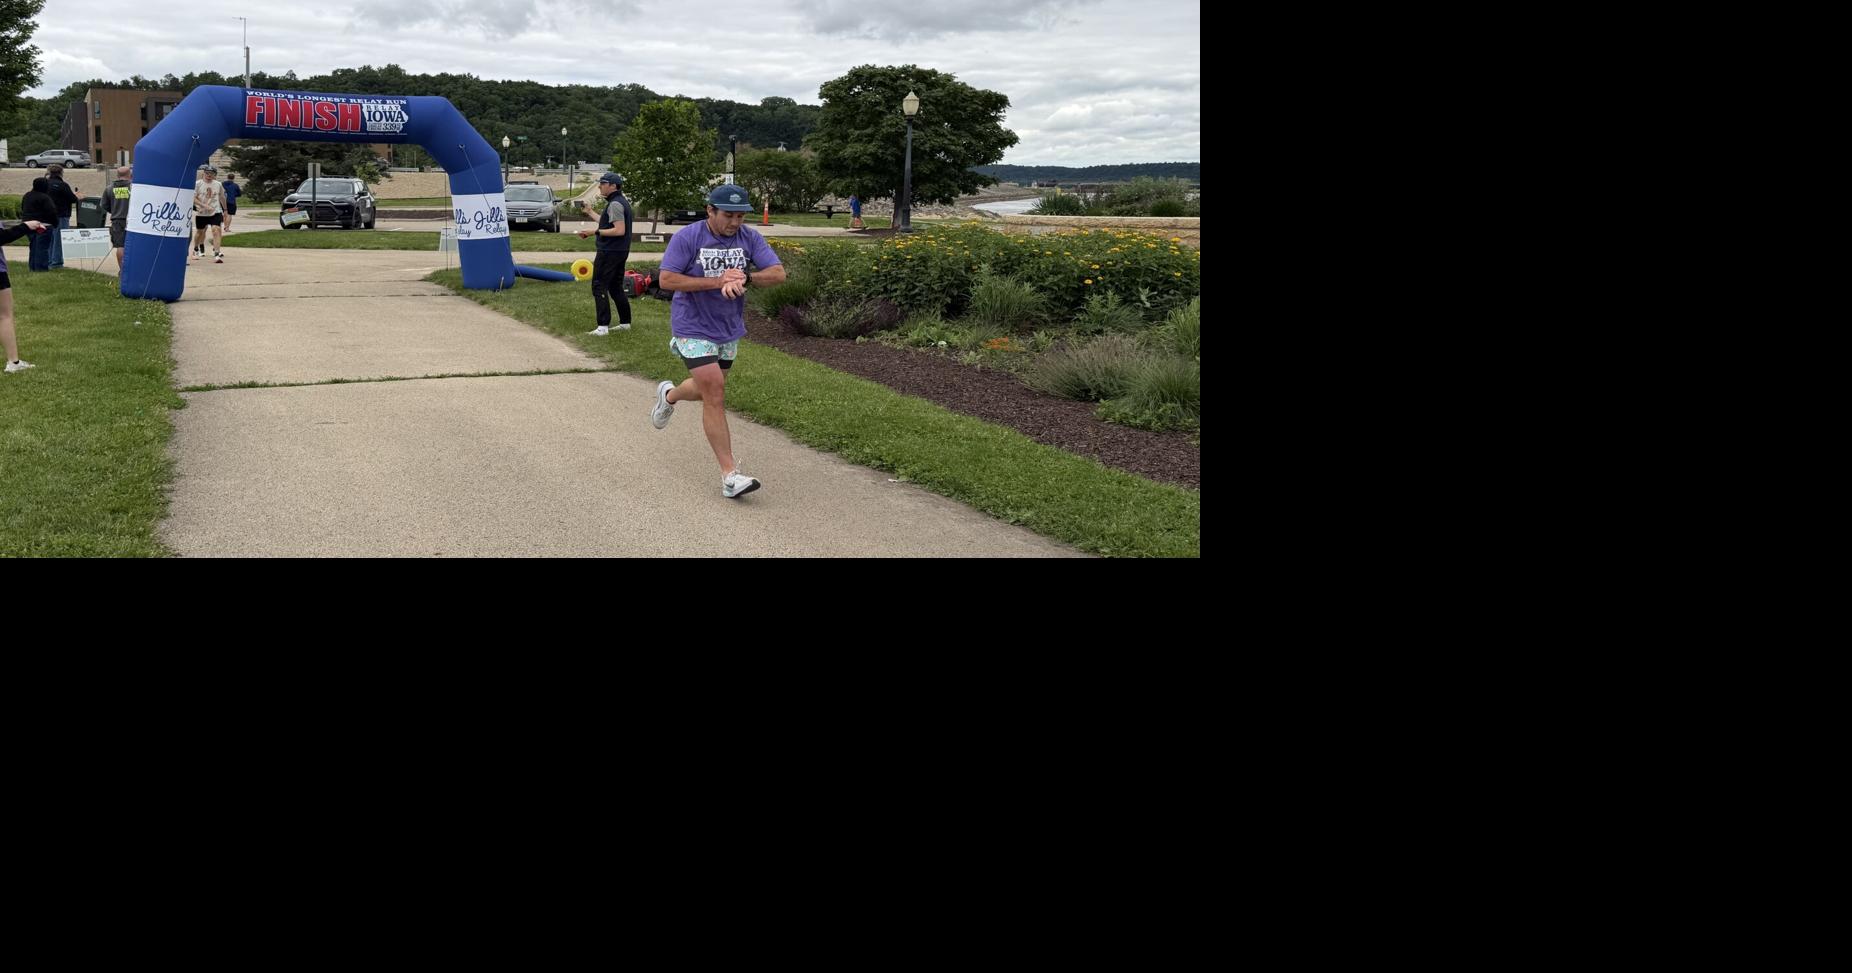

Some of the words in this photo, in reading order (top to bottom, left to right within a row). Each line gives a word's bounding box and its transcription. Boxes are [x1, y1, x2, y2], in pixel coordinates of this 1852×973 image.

[246, 90, 295, 99] WORLD'S
[297, 94, 346, 103] LONGEST
[245, 95, 362, 132] FINISH
[366, 110, 406, 122] IOWA
[142, 202, 185, 224] Jill's
[455, 208, 472, 225] ll's
[474, 206, 506, 230] Jill's
[151, 219, 183, 236] Relay
[484, 223, 507, 235] Relay
[716, 249, 742, 257] RELAY
[703, 256, 745, 270] IOWA
